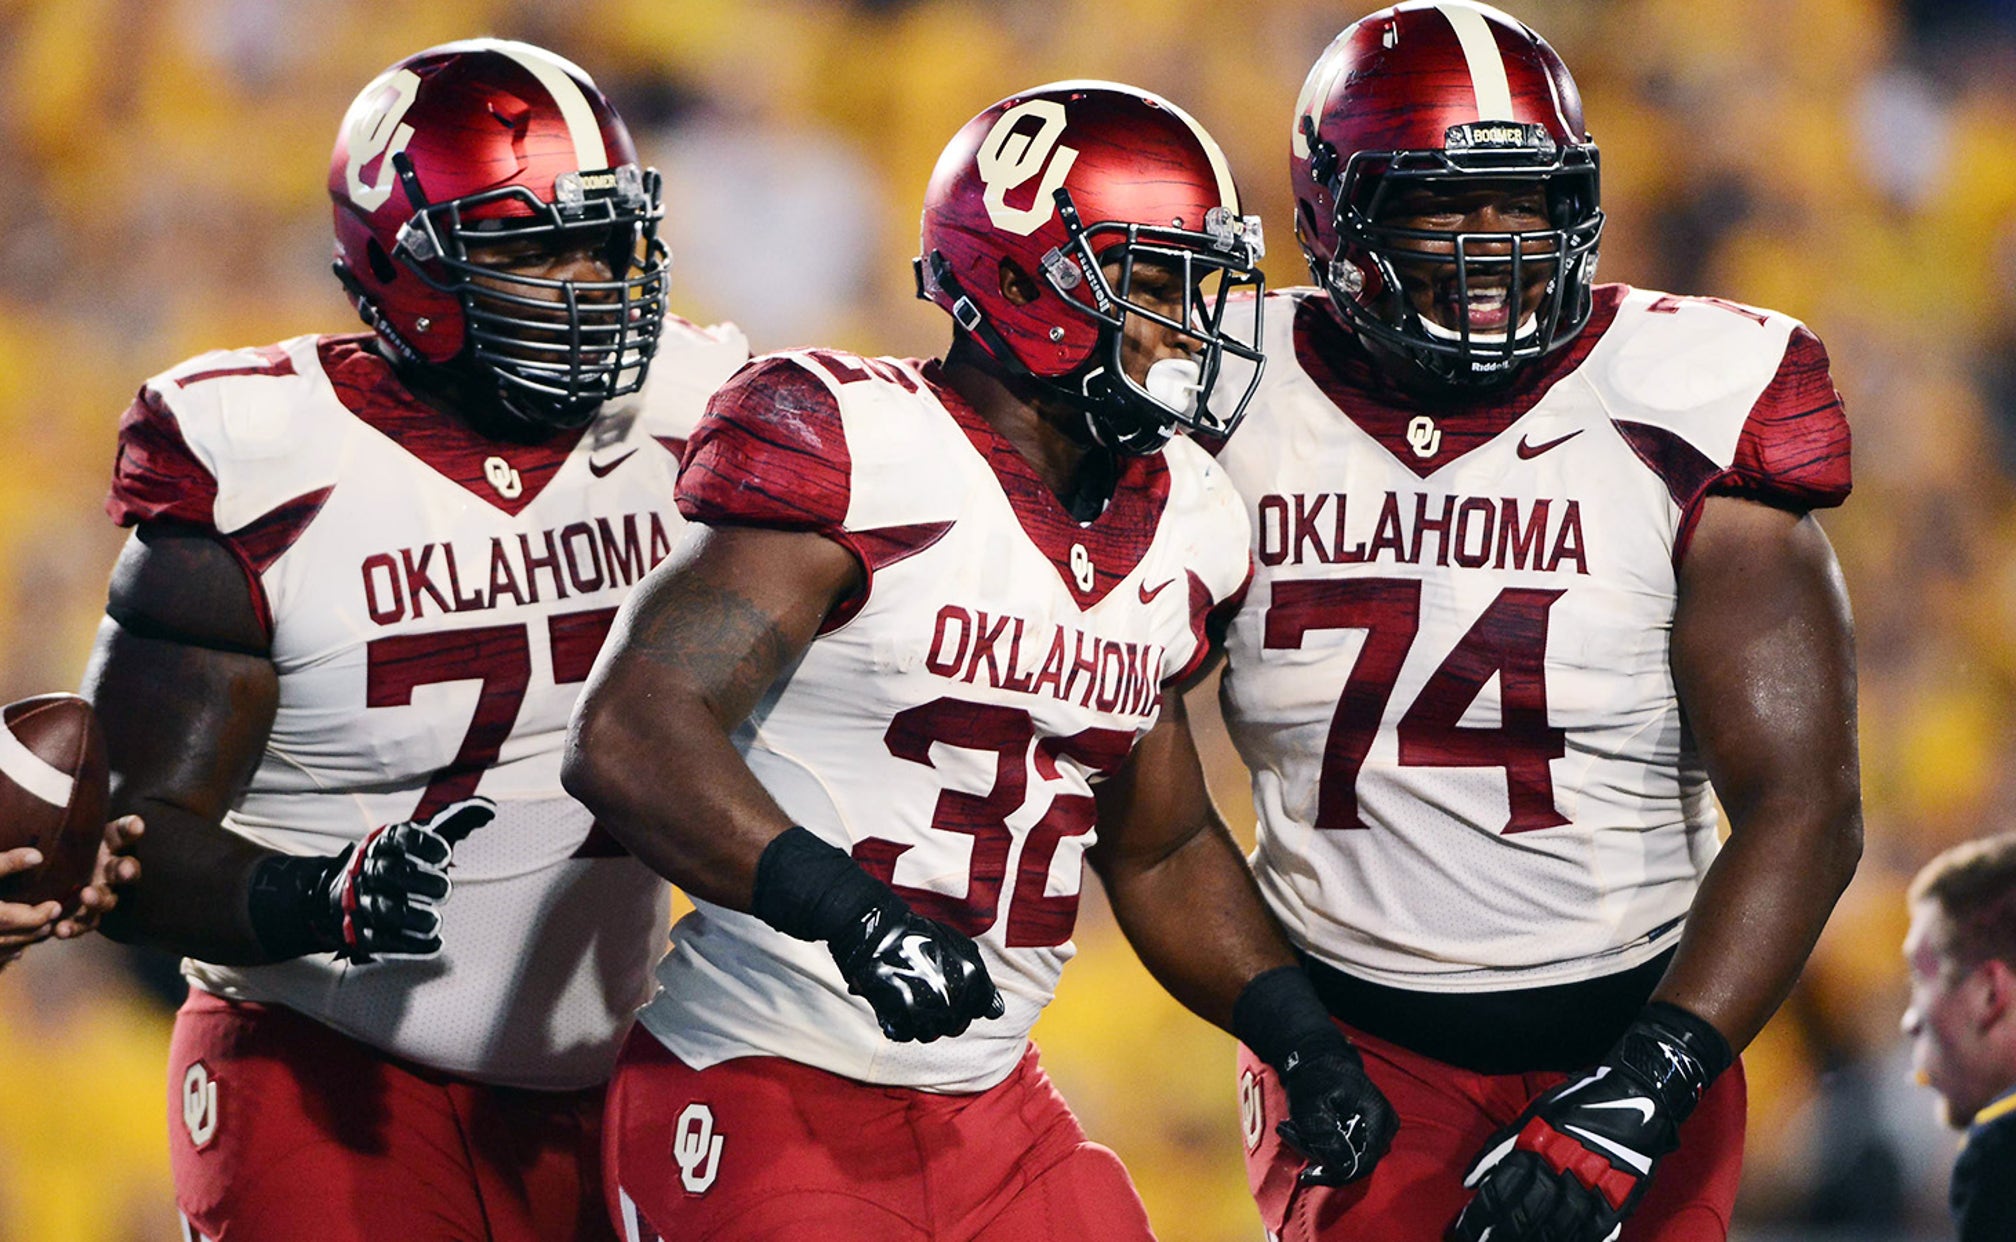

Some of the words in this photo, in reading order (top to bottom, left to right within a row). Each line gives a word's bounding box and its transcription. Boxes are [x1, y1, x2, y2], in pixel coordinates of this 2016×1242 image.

[346, 68, 422, 213] OU
[976, 99, 1080, 237] OU
[1473, 127, 1523, 146] BOOMER
[484, 456, 523, 498] OU
[1406, 415, 1442, 458] OU
[361, 511, 672, 626] OKLAHOMA
[1070, 543, 1094, 593] OU
[1258, 491, 1591, 576] OKLAHOMA
[1263, 577, 1574, 835] 74
[851, 696, 1137, 948] 32
[183, 1062, 218, 1146] OU
[674, 1103, 724, 1193] OU
